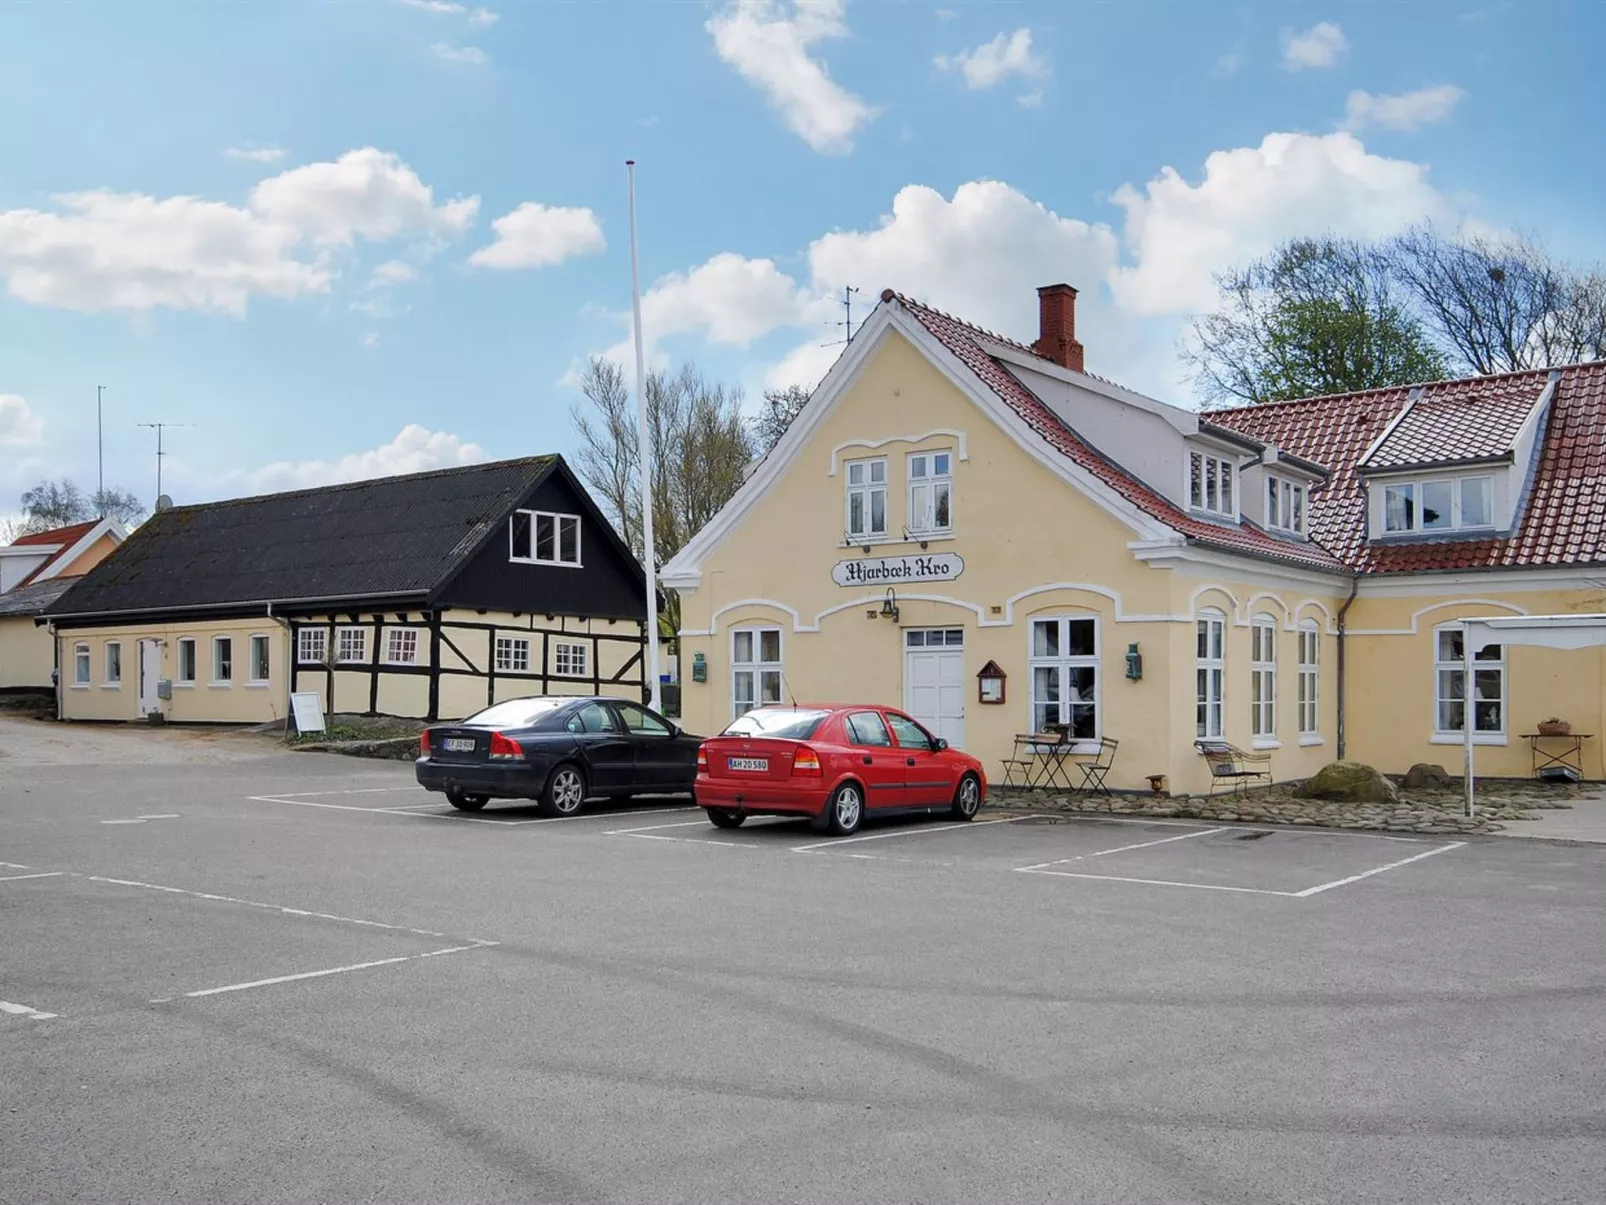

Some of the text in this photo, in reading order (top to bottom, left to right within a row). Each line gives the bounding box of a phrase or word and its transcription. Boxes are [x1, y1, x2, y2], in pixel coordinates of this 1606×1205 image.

[915, 557, 950, 576] Kro
[733, 759, 742, 768] AH
[743, 760, 752, 768] 20
